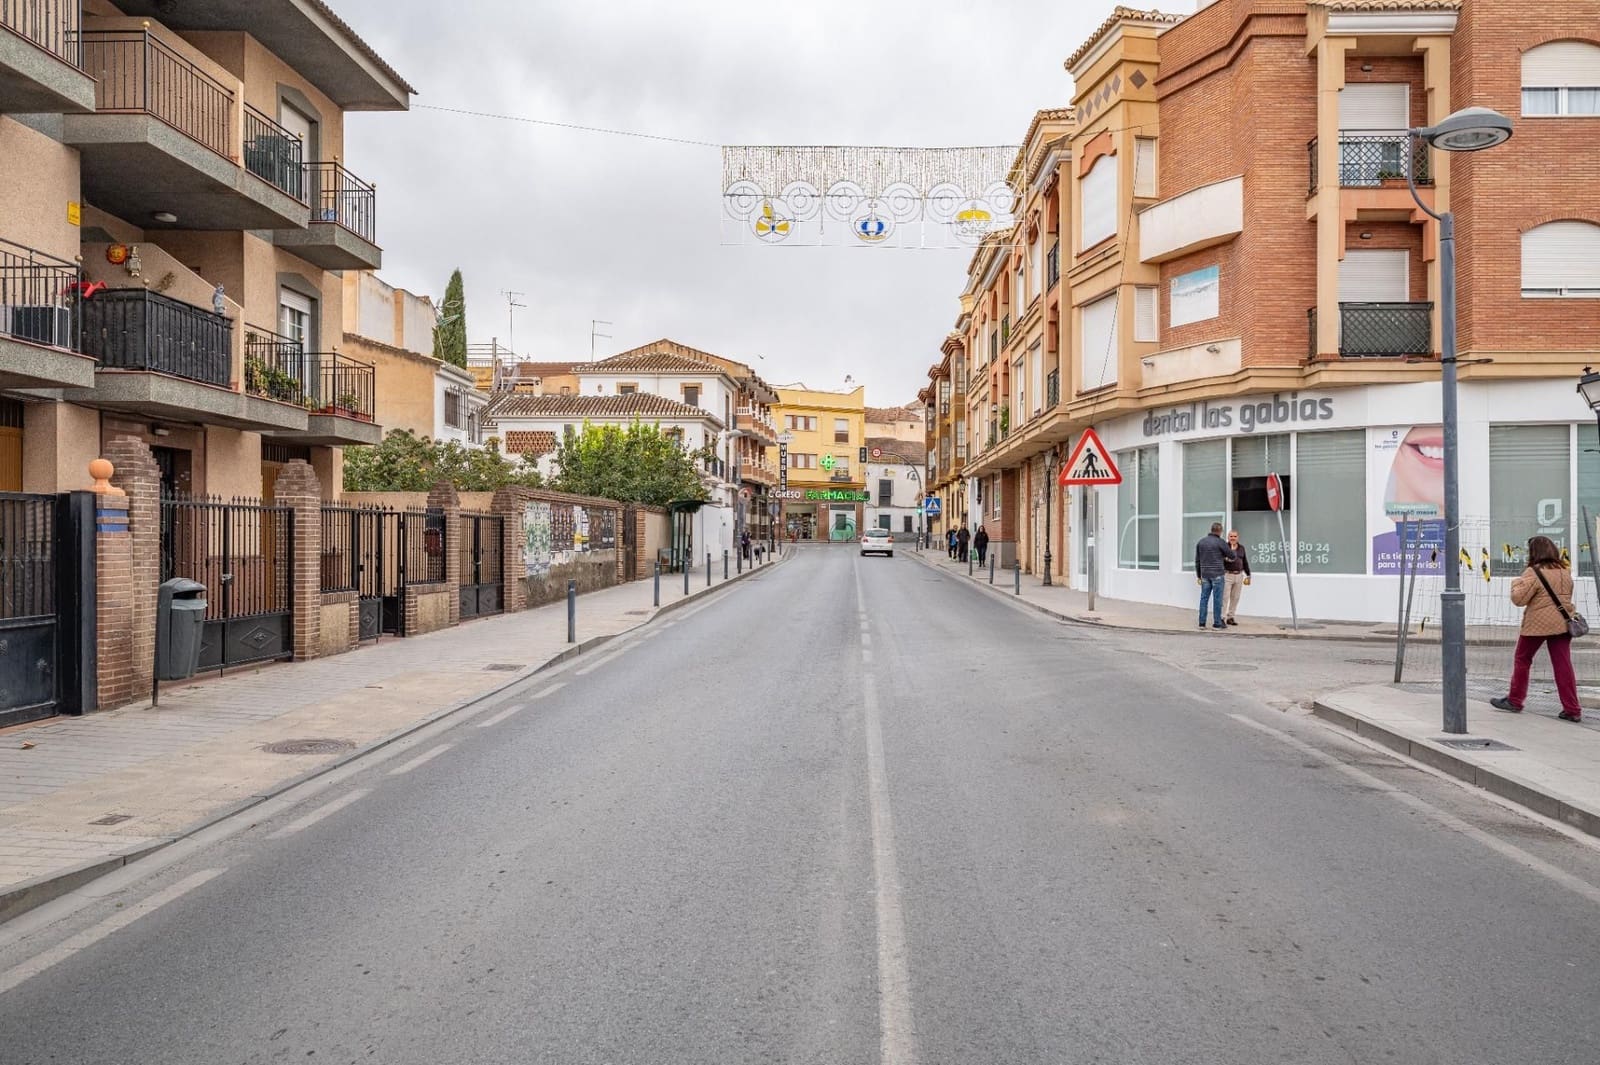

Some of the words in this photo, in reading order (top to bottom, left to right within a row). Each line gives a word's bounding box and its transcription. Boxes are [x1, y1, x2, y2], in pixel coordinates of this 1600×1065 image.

[1142, 402, 1196, 437] dental
[1201, 400, 1233, 429] las
[1240, 392, 1334, 433] gabias
[805, 489, 865, 501] FARMACIA
[1258, 541, 1276, 553] 958
[1298, 541, 1313, 552] 80
[1316, 543, 1330, 553] 24
[1258, 552, 1277, 564] 626
[1297, 553, 1312, 565] 48
[1316, 554, 1329, 564] 16
[1377, 552, 1391, 561] ¡Es
[1377, 561, 1396, 570] para
